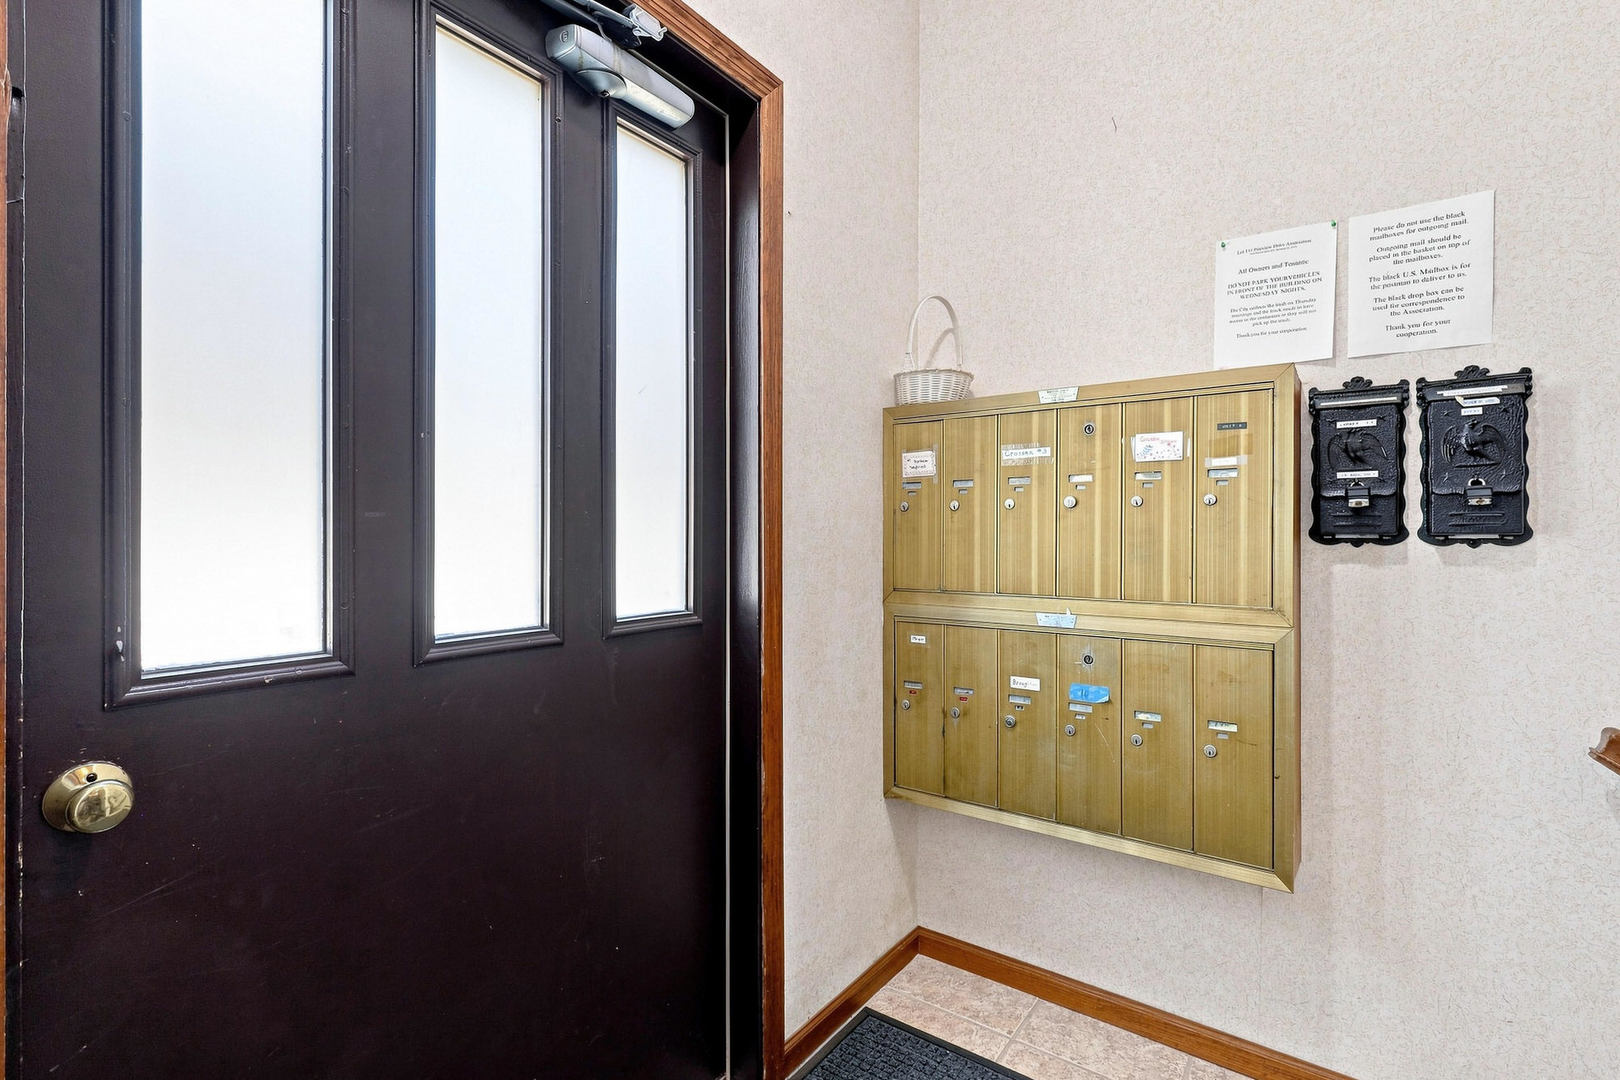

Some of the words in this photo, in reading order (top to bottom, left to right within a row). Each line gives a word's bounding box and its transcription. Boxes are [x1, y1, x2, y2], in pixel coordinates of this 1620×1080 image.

[1373, 223, 1395, 233] Please
[1445, 210, 1466, 220] black
[1369, 230, 1404, 241] mailboxes
[1405, 227, 1416, 235] for
[1418, 222, 1449, 233] outgoing
[1376, 242, 1408, 253] Outgoing
[1409, 239, 1425, 248] mail
[1427, 234, 1451, 245] should
[1369, 253, 1391, 263] placed
[1400, 249, 1411, 257] the
[1413, 245, 1436, 255] basket
[1448, 241, 1460, 250] top
[1405, 253, 1443, 264] mailboxes.
[1248, 265, 1270, 273] Owners
[1271, 262, 1282, 270] and
[1369, 275, 1381, 283] The
[1382, 272, 1400, 282] black
[1419, 266, 1449, 276] Mailbox
[1460, 262, 1471, 270] for
[1270, 275, 1288, 283] YOUR
[1288, 271, 1320, 281] VEHICLES
[1382, 280, 1411, 290] postman
[1421, 274, 1446, 284] deliver
[1235, 286, 1255, 295] FRONT
[1266, 282, 1277, 290] THE
[1279, 278, 1311, 288] BUILDING
[1312, 276, 1322, 284] ON
[1240, 290, 1278, 300] WEDNESDAY
[1387, 294, 1406, 302] black
[1407, 291, 1424, 300] drop
[1425, 289, 1439, 297] box
[1400, 296, 1456, 308] correspondence
[1402, 305, 1445, 316] Association.
[1385, 323, 1406, 332] Thank
[1407, 322, 1421, 330] you
[1422, 319, 1433, 327] for
[1435, 318, 1451, 327] your
